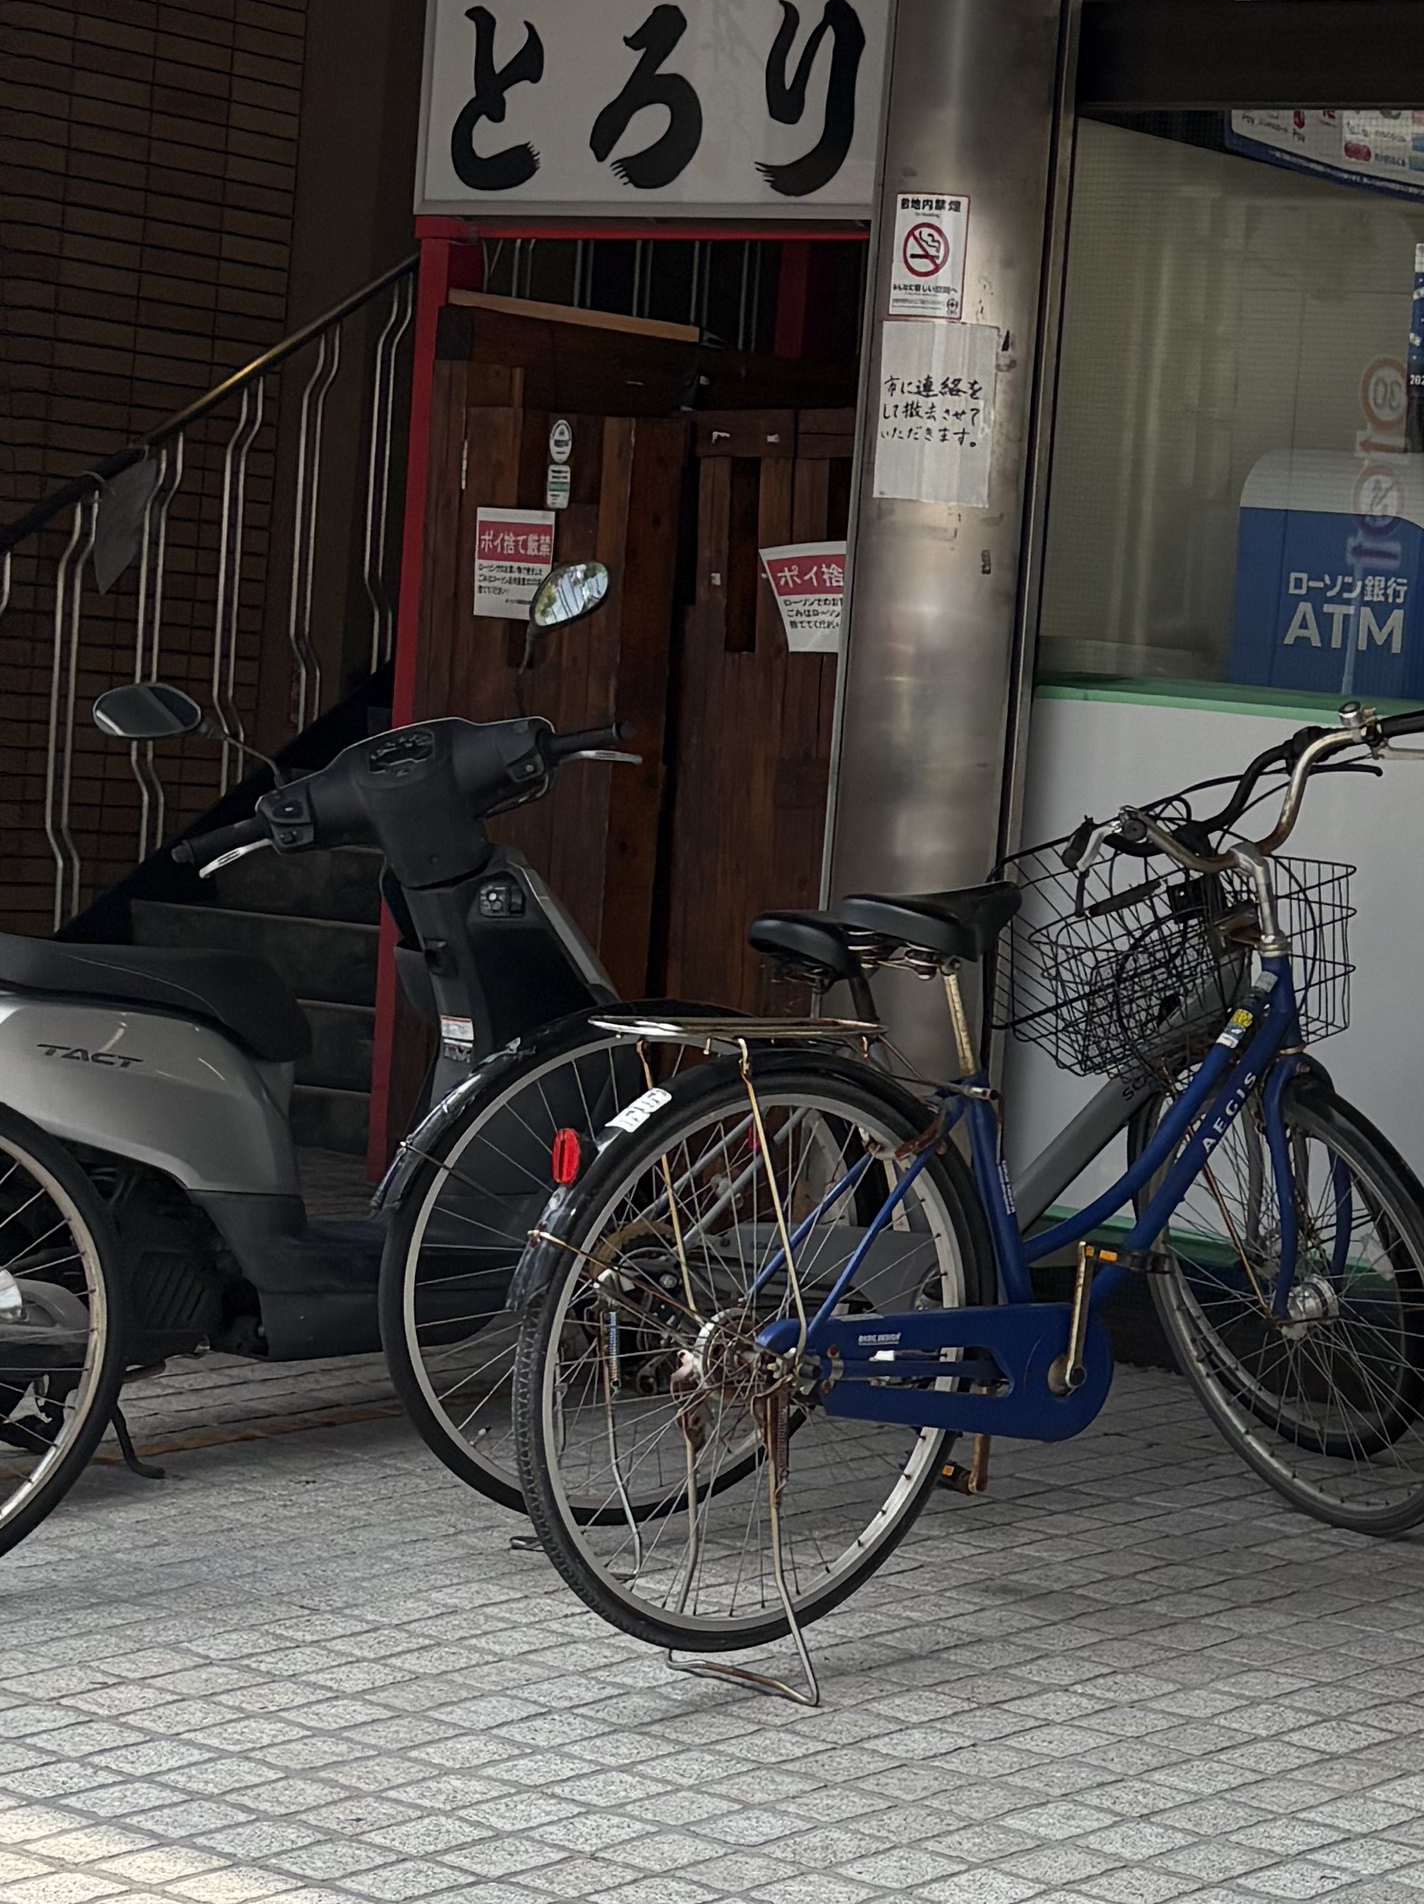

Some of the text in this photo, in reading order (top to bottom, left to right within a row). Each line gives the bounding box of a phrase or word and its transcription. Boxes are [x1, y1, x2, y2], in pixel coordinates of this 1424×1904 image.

[884, 375, 983, 400] 市に連絡を
[881, 426, 977, 447] いただきます。
[480, 529, 551, 556] ポイ捨て厳禁
[1288, 572, 1408, 604] ローソン銀行
[1283, 603, 1405, 654] ATM
[37, 1044, 143, 1068] TACT
[1202, 1072, 1257, 1153] AEGIS
